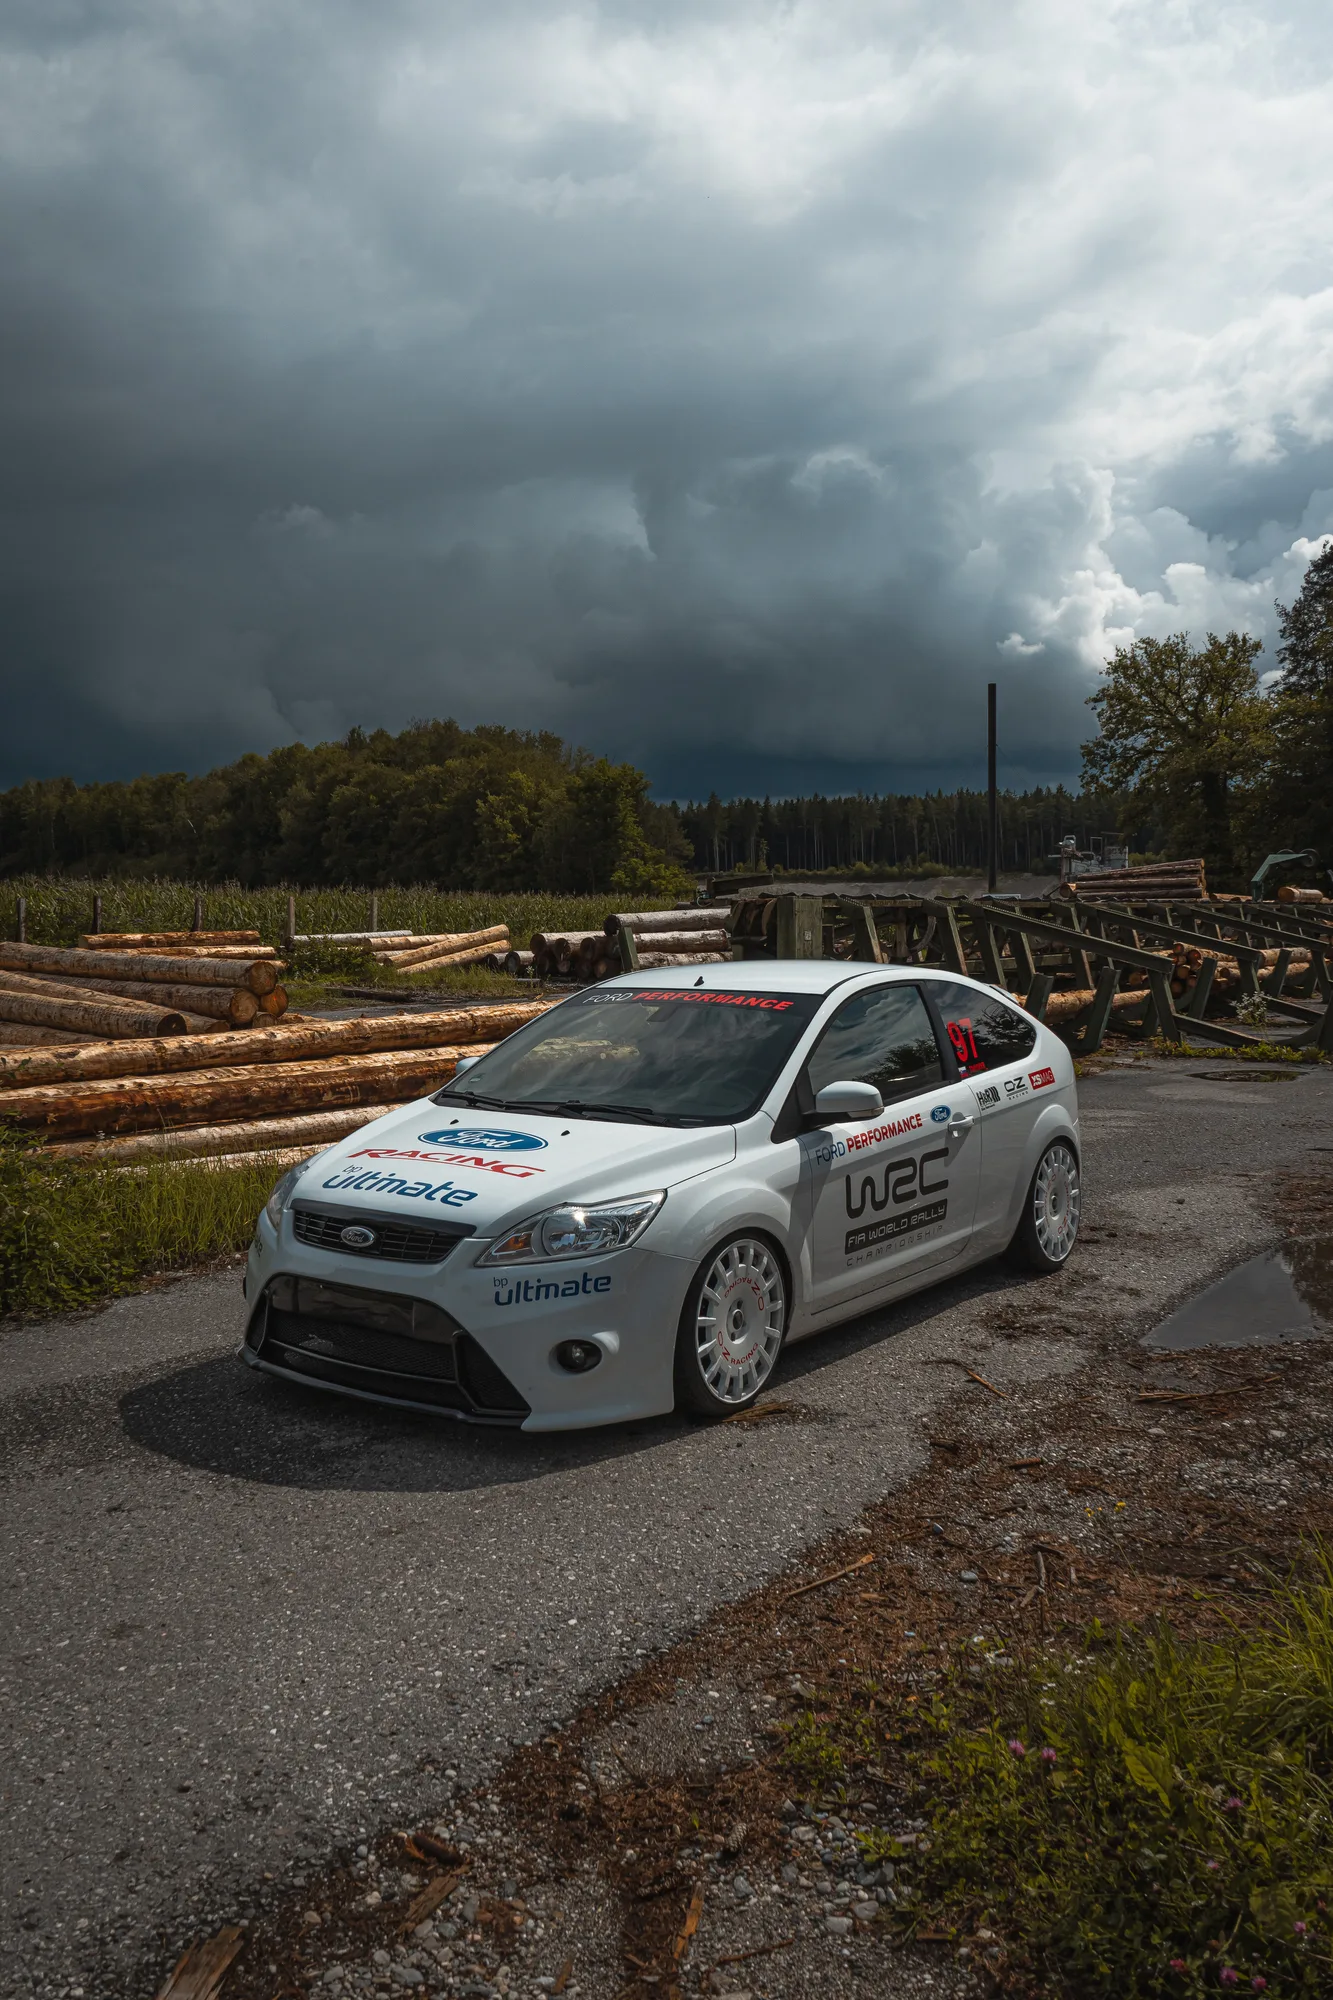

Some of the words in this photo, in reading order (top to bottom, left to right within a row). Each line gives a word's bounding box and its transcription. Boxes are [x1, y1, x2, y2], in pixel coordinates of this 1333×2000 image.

[583, 992, 633, 1004] FORD
[631, 992, 794, 1011] PERFORMANCE
[947, 1017, 978, 1062] 97
[438, 1130, 525, 1149] Ford
[815, 1141, 846, 1165] FORD
[846, 1113, 923, 1153] PERFORMANCE
[342, 1164, 363, 1175] bp
[346, 1149, 546, 1178] RACING
[322, 1171, 478, 1207] ultimate
[846, 1147, 949, 1219] WRC
[848, 1233, 866, 1248] FIA
[868, 1219, 908, 1240] WORLD
[910, 1205, 946, 1226] RALLY
[847, 1225, 943, 1267] CHAMPIONSHIP
[493, 1277, 508, 1289] bp
[494, 1272, 611, 1306] ultimate
